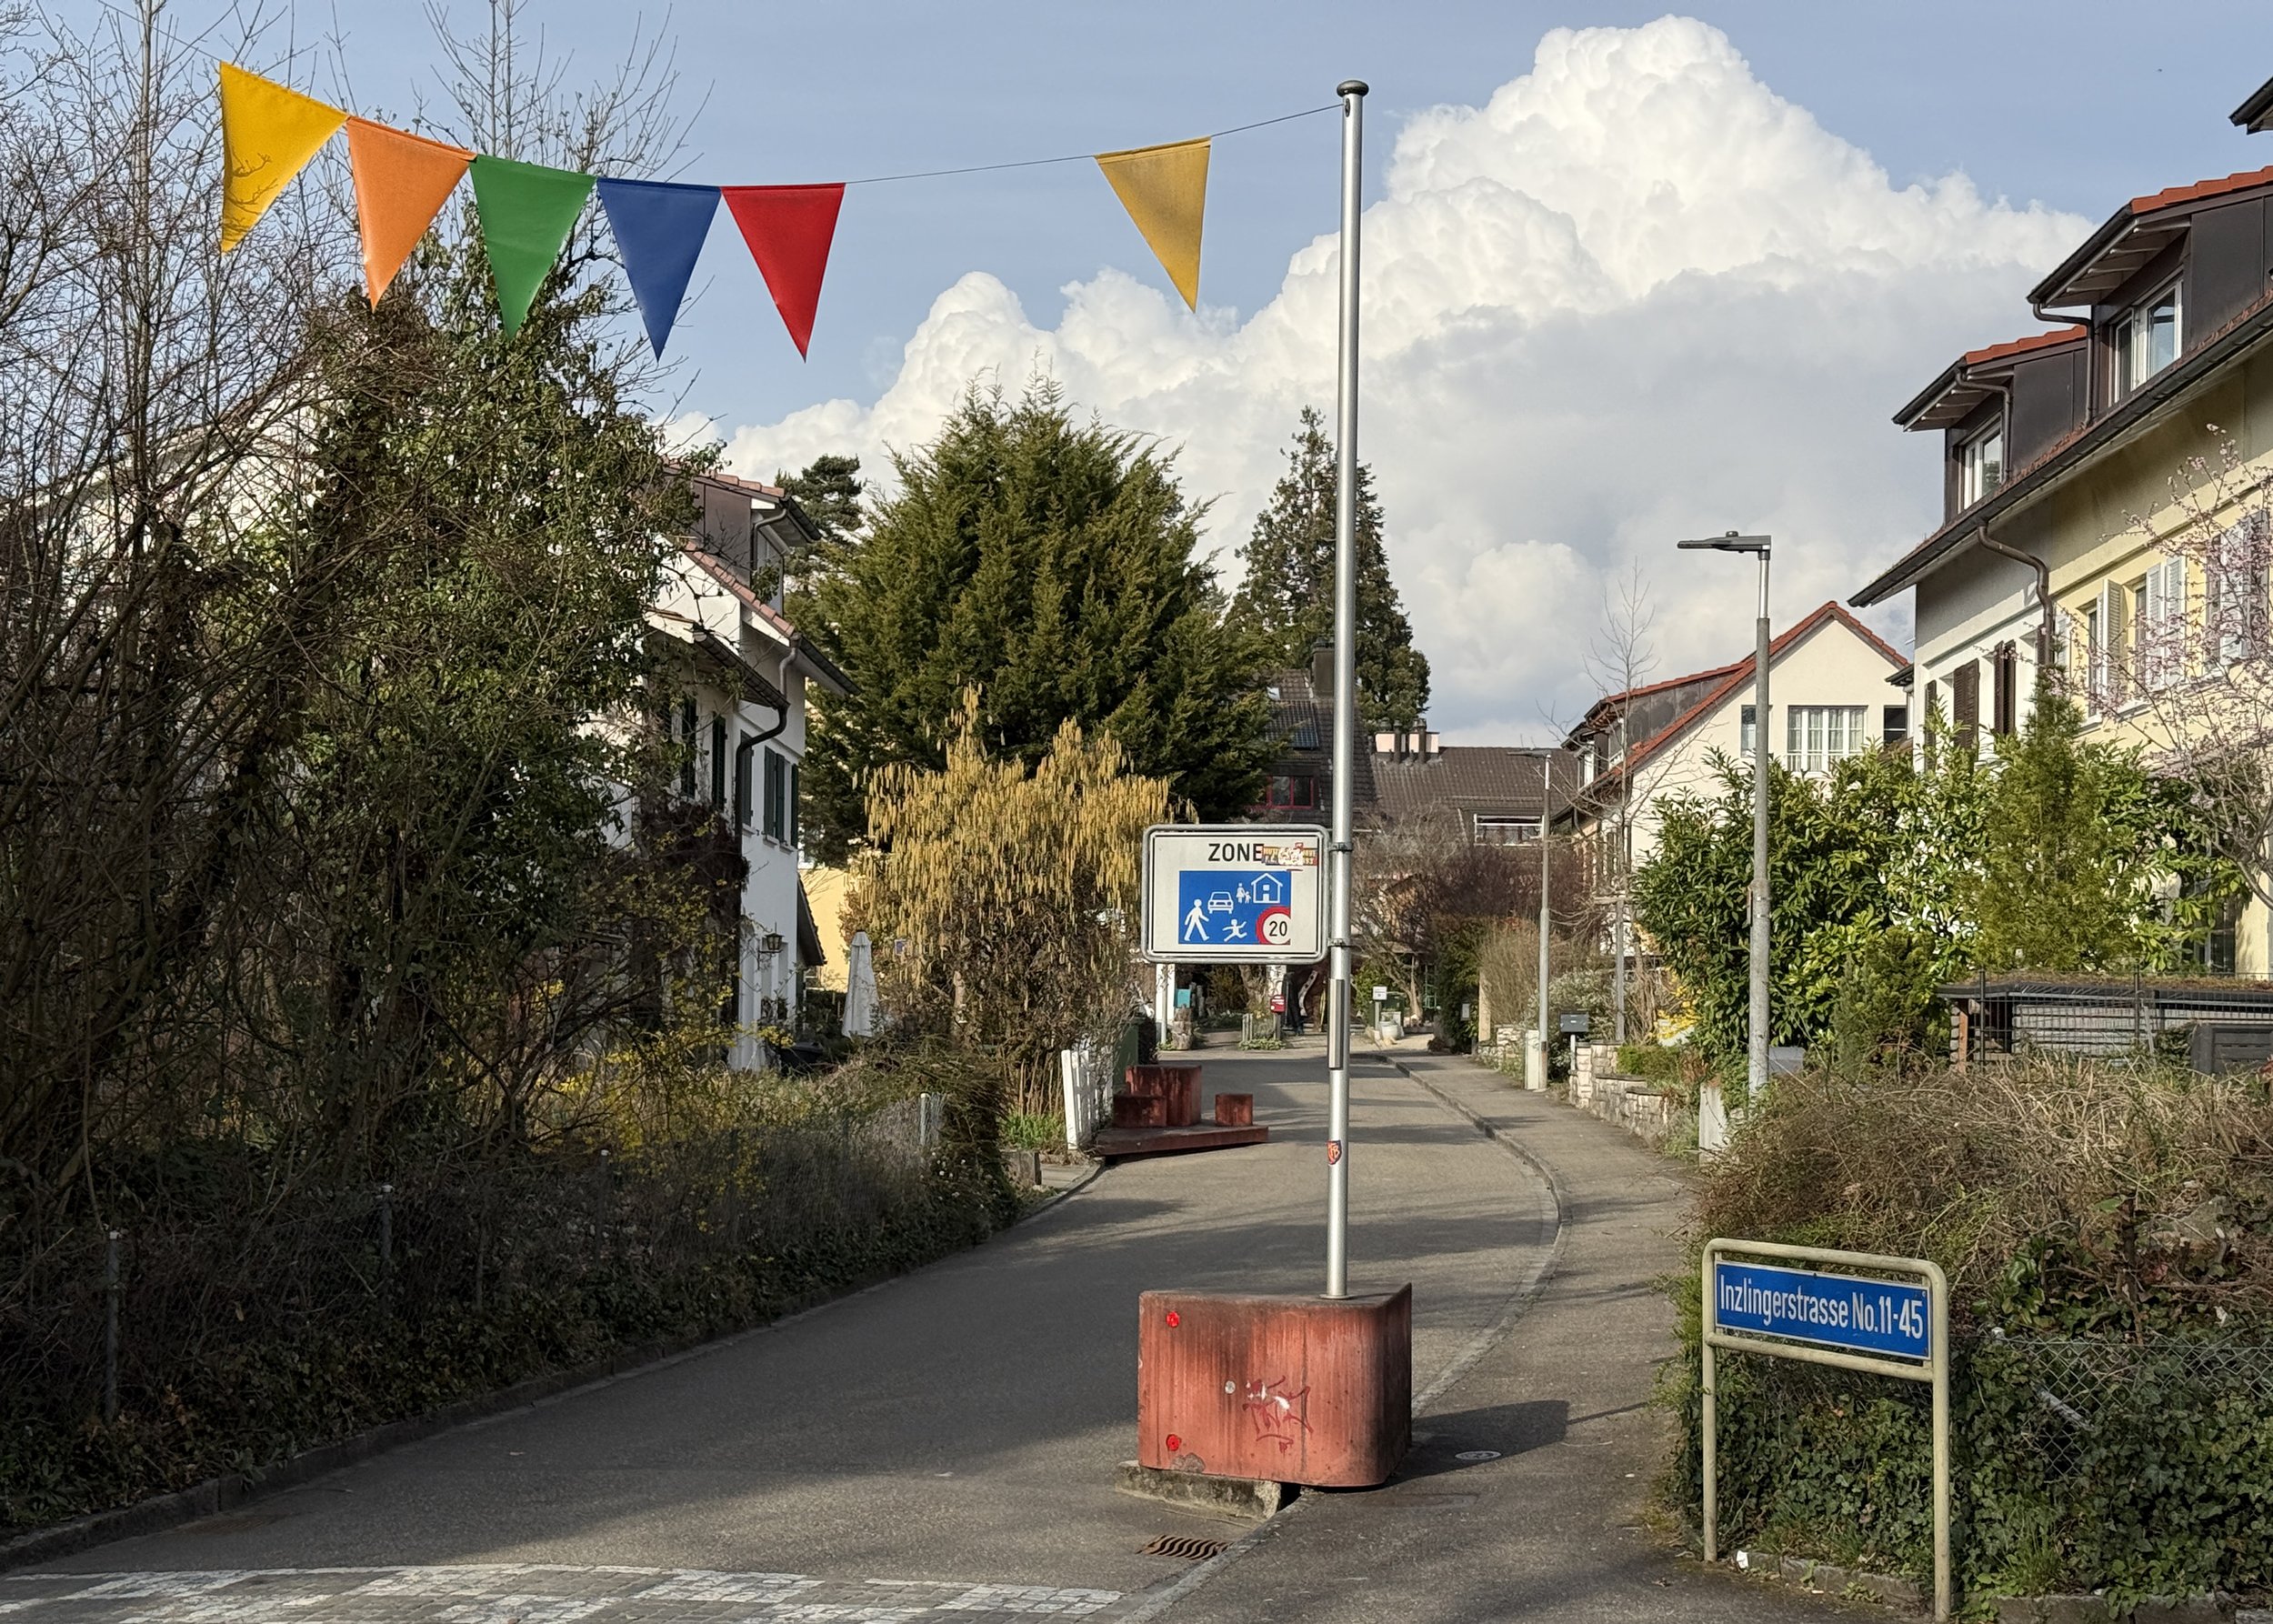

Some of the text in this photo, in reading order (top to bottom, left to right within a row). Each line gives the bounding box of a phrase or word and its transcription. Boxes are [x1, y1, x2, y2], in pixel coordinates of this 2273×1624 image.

[1208, 843, 1265, 861] ZONE
[1268, 920, 1287, 937] 20
[1720, 1274, 1848, 1328] Inzlingerstrasse
